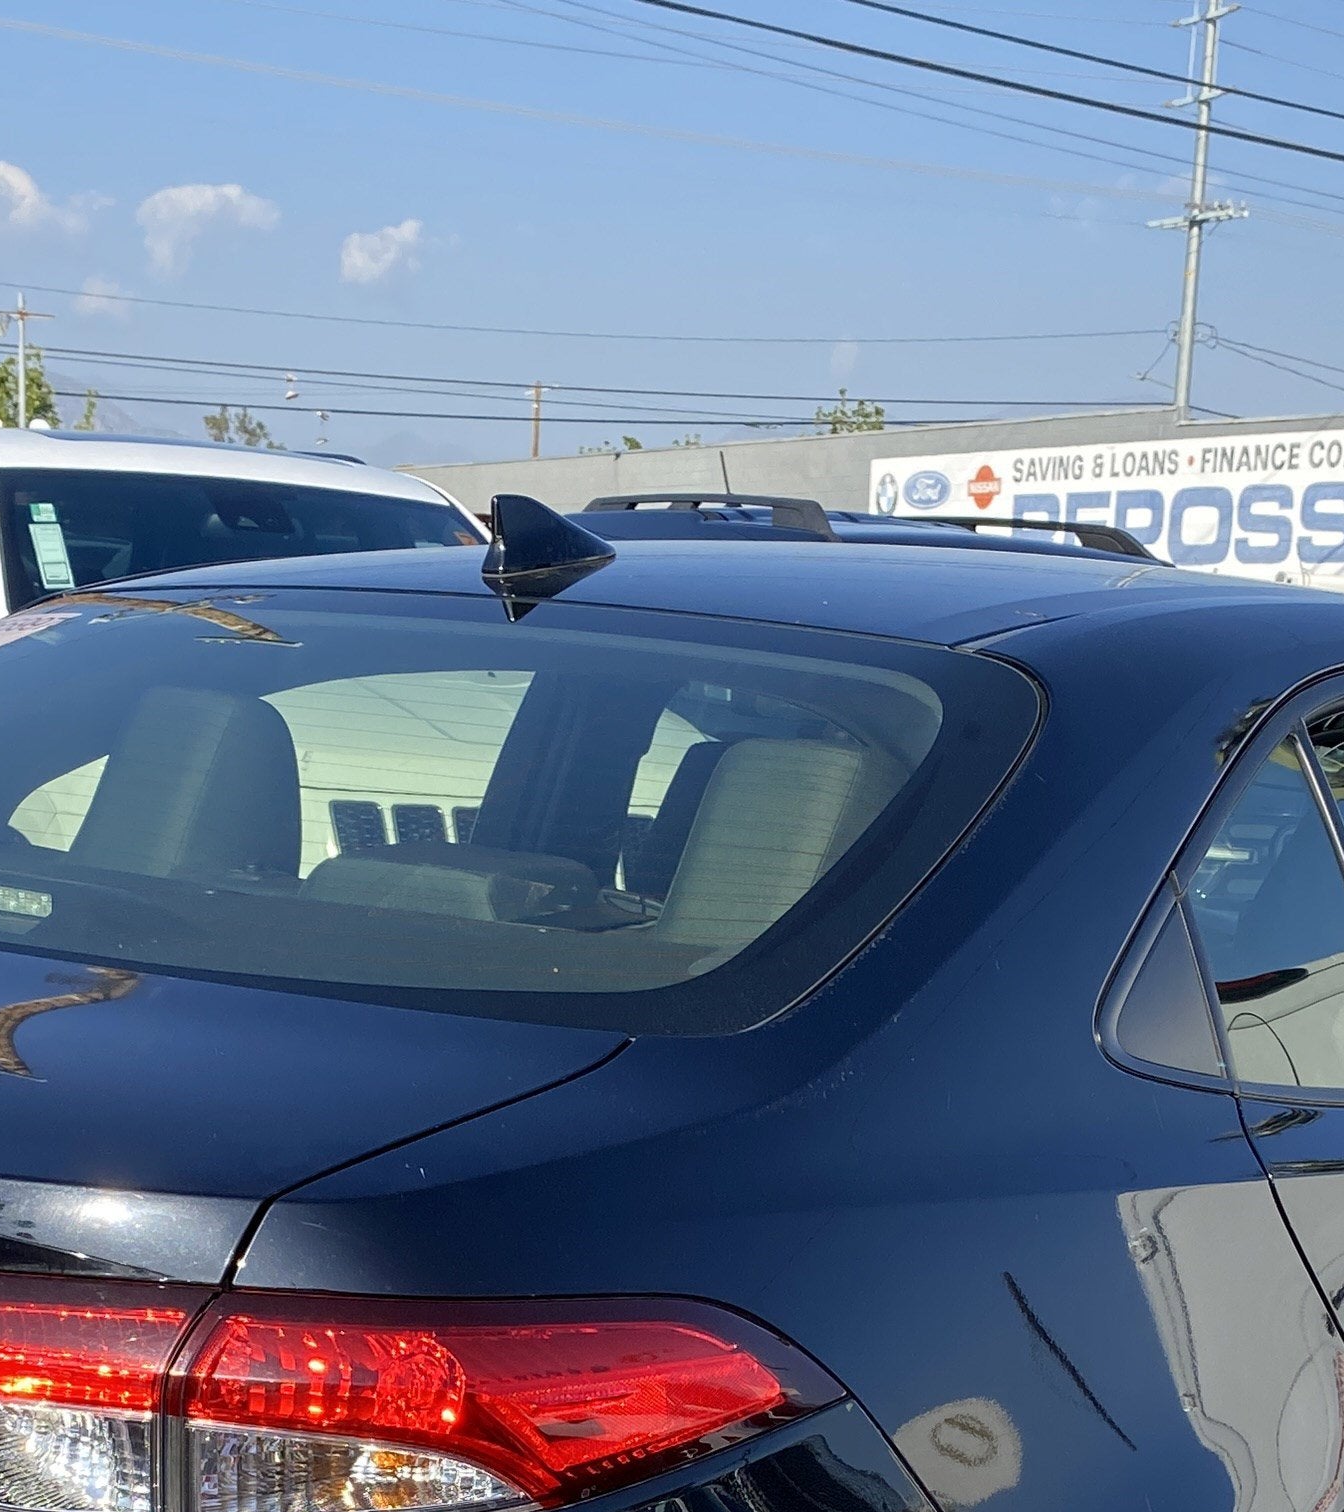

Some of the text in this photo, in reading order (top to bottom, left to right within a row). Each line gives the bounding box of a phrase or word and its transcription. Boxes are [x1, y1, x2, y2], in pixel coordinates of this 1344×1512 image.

[1012, 454, 1084, 484] SAVING
[1092, 453, 1104, 478] &
[1109, 449, 1180, 478] LOANS
[1199, 441, 1301, 474] FINANCE
